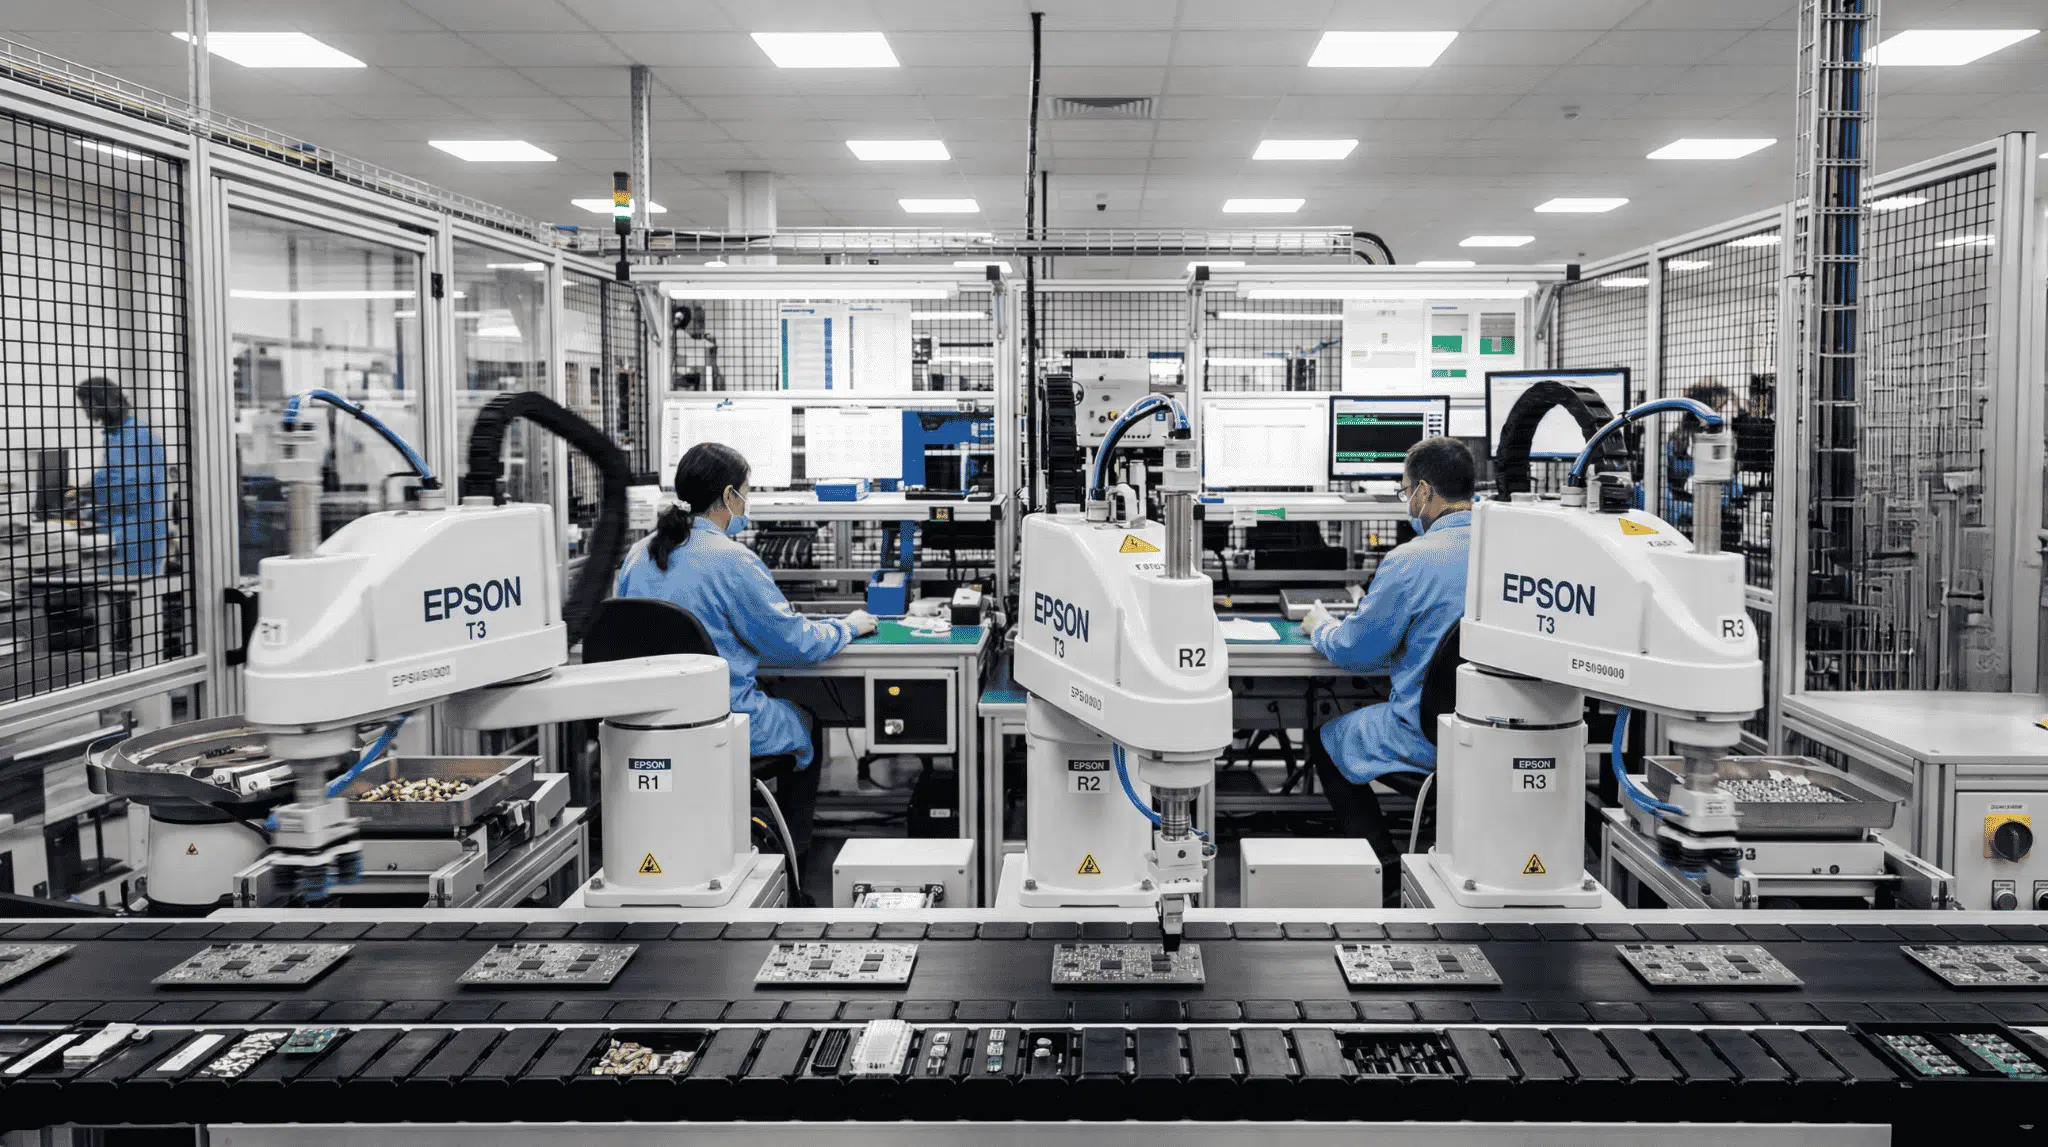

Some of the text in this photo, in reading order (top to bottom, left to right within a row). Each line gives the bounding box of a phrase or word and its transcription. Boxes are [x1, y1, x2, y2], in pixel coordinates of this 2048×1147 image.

[424, 576, 522, 623] EPSON
[1503, 573, 1596, 617] EPSON
[1034, 591, 1090, 643] EPSON
[1536, 614, 1555, 635] T3
[466, 620, 487, 640] T3
[1722, 618, 1745, 638] R3
[1052, 636, 1065, 659] T3
[1178, 647, 1207, 669] R2
[634, 760, 666, 769] EPSON
[1073, 761, 1105, 770] EPSON
[1518, 760, 1551, 769] EPSON
[638, 774, 658, 790] R1
[1077, 775, 1101, 791] R2
[1523, 774, 1547, 790] R3
